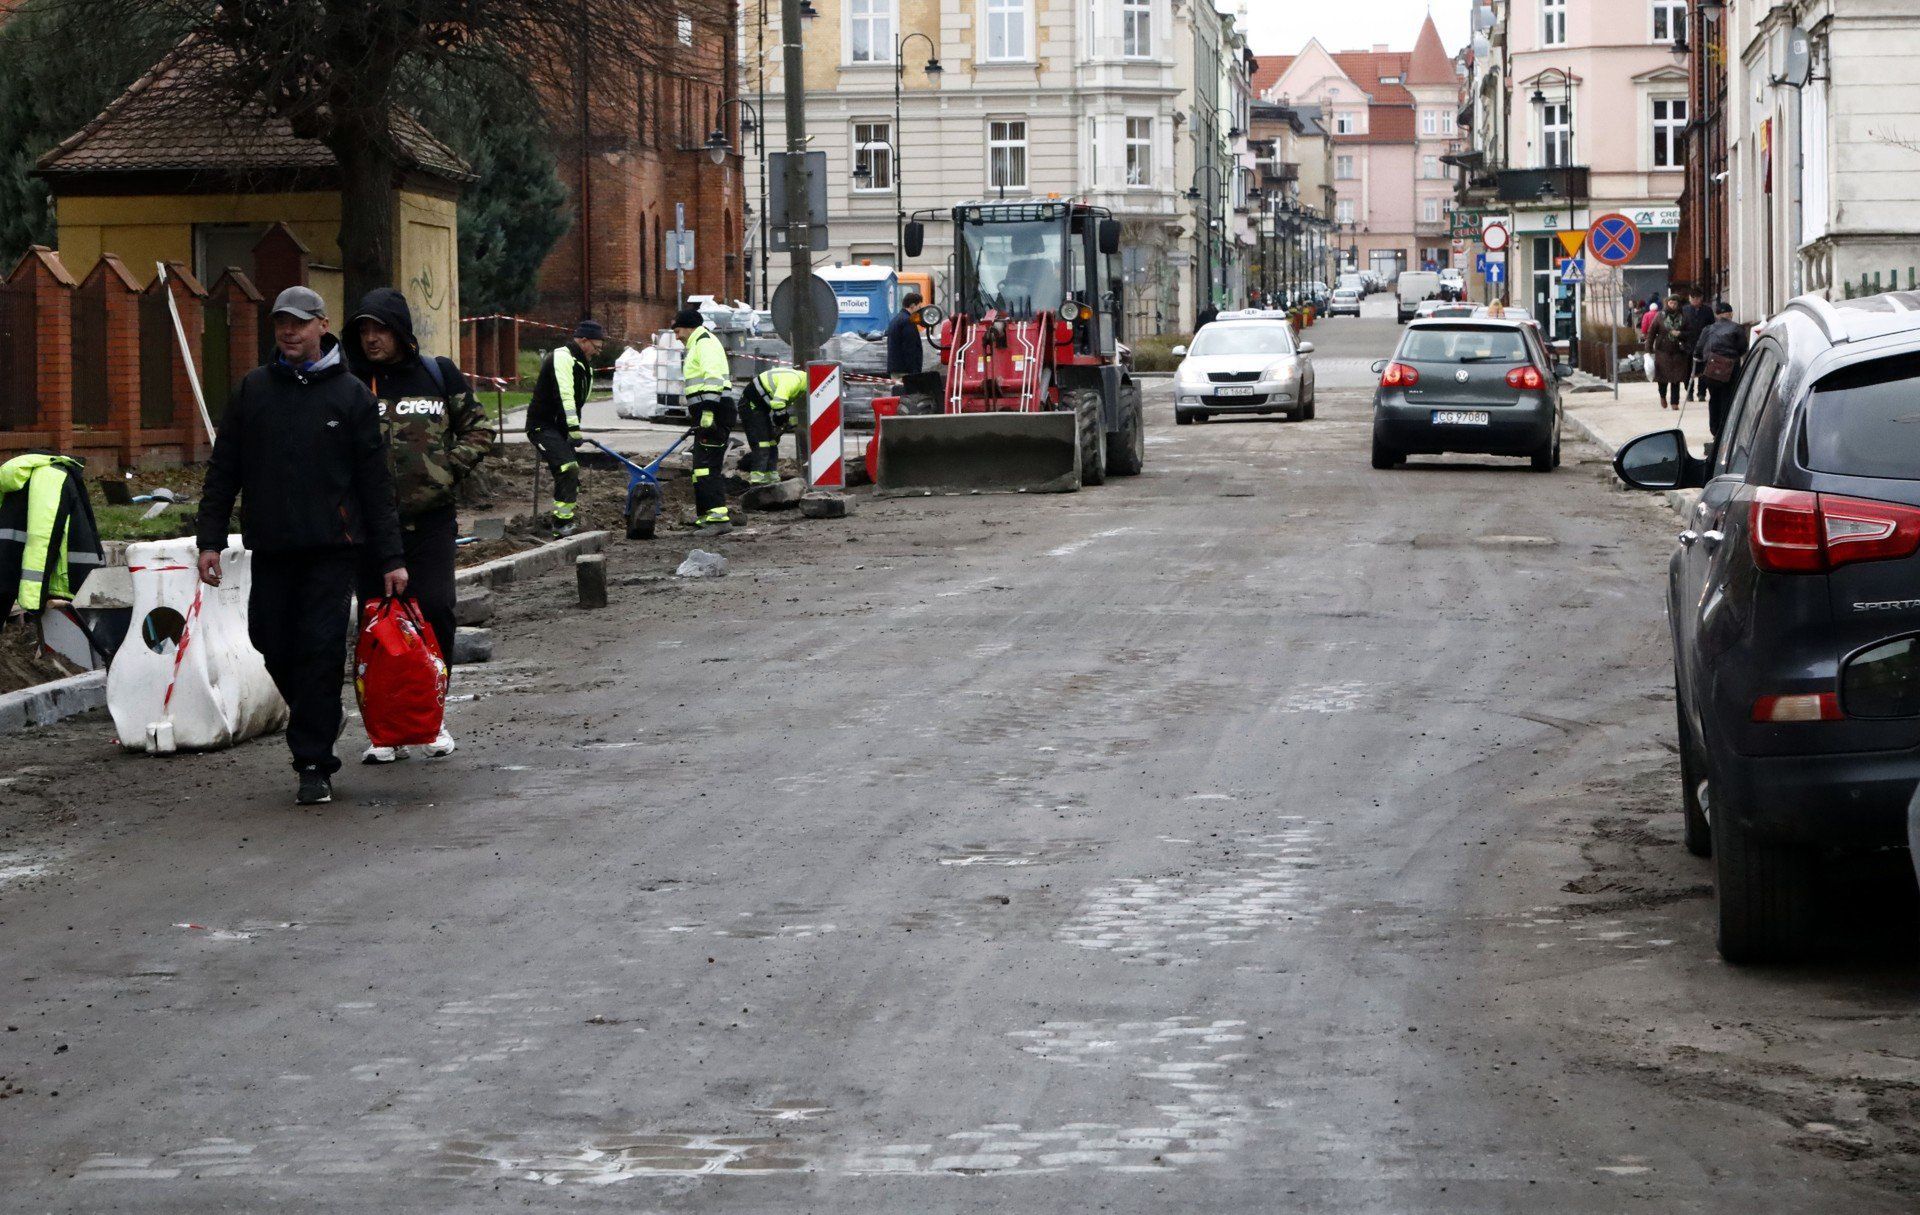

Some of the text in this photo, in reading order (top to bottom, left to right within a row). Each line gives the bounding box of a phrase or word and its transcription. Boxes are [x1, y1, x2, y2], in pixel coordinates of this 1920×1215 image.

[1453, 213, 1482, 228] FO
[1439, 412, 1487, 422] CG 97080
[1853, 600, 1920, 611] SPORTA
